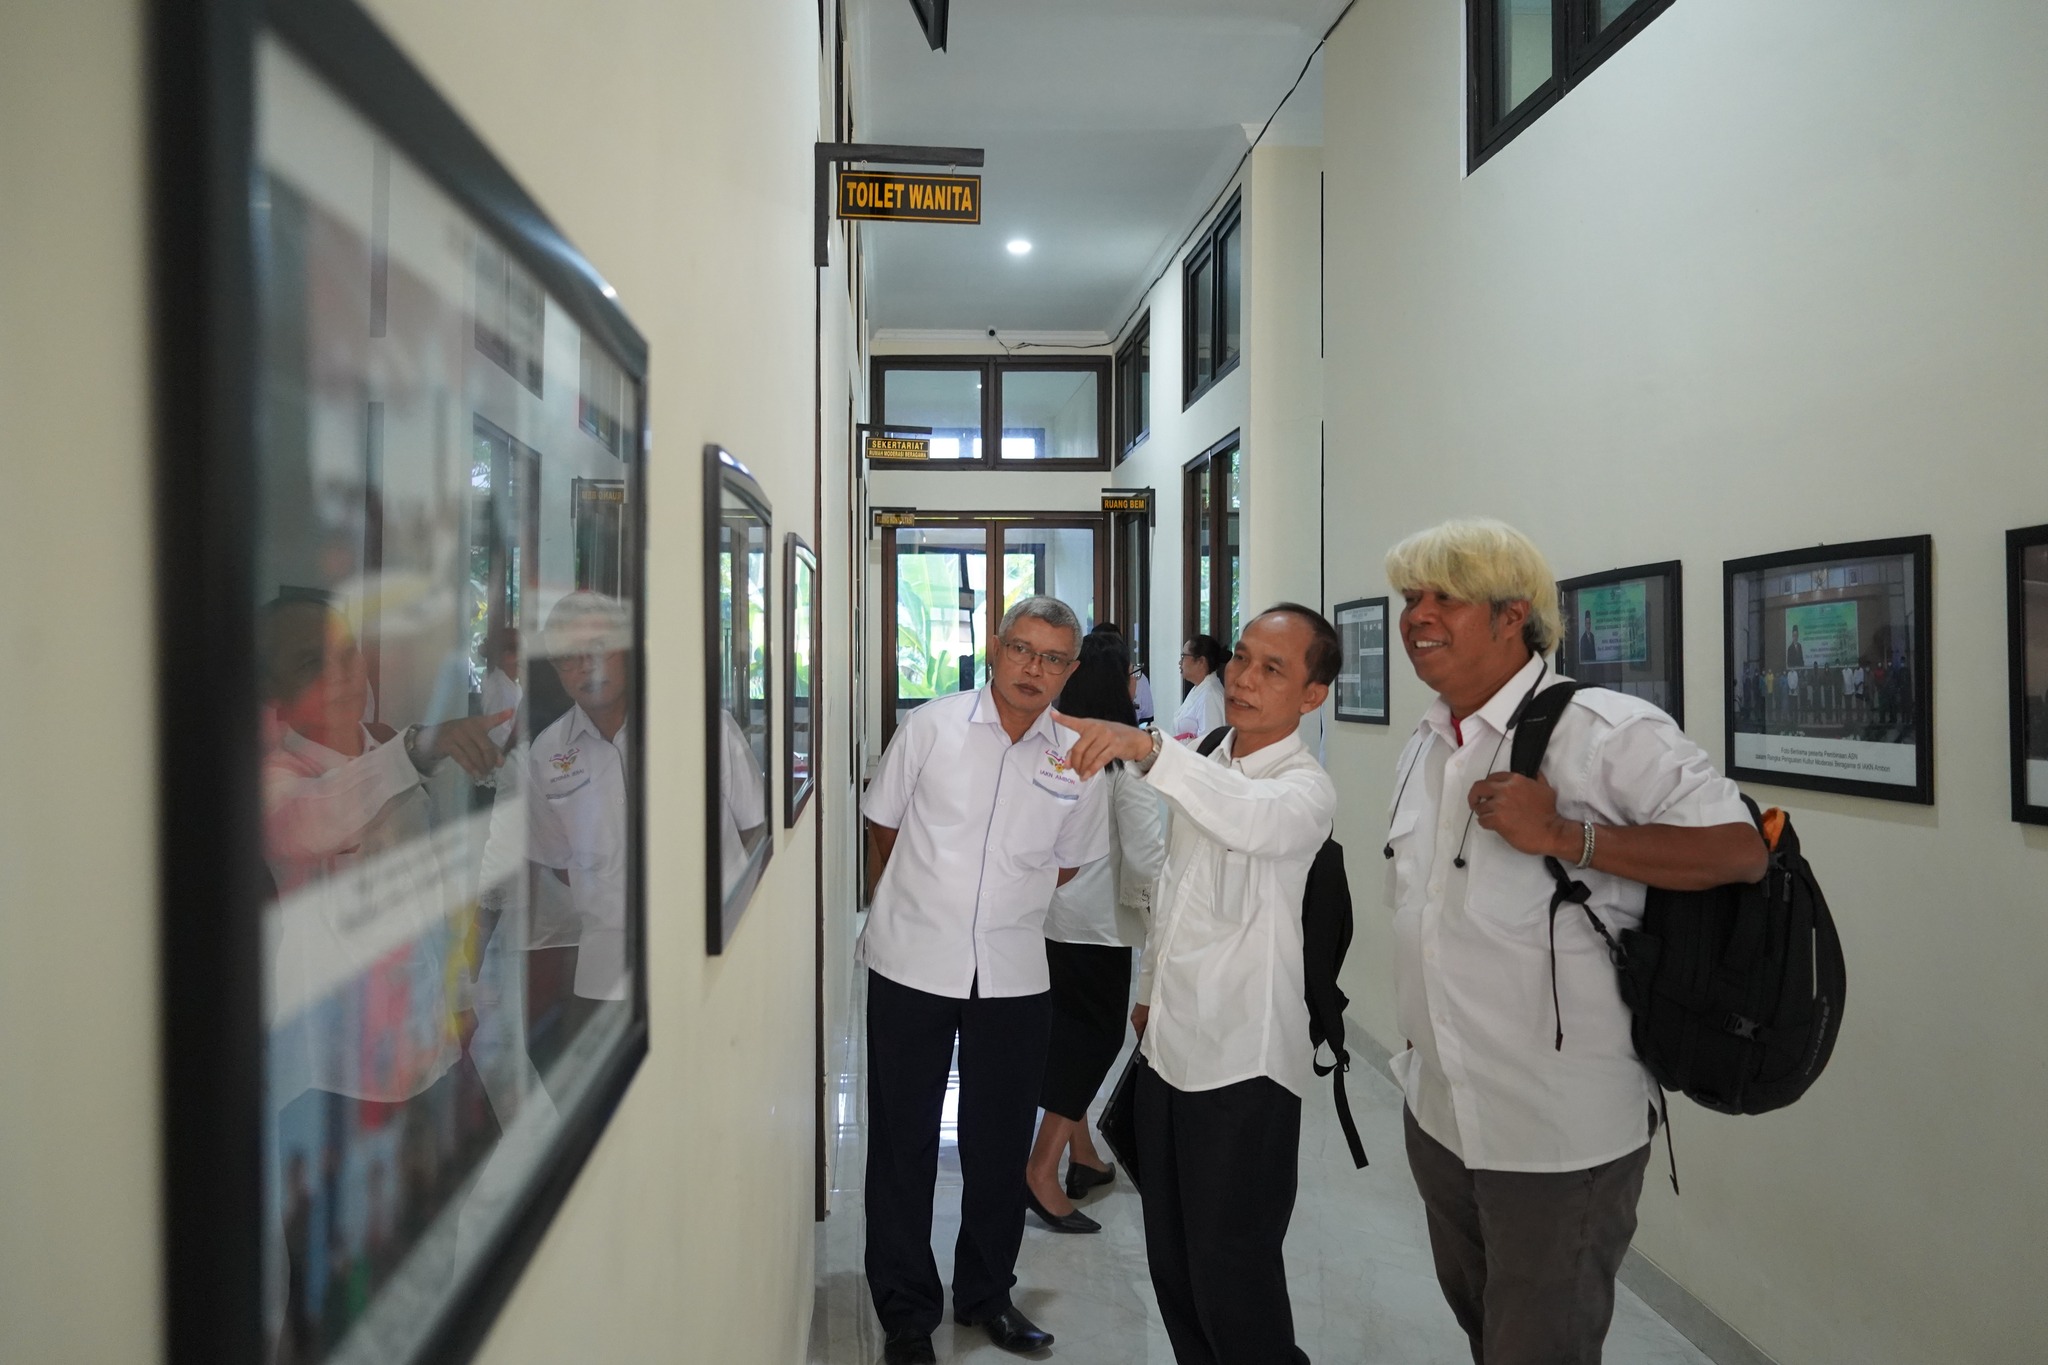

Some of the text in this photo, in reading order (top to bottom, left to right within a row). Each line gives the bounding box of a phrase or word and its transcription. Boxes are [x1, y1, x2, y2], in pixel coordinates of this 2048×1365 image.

[846, 181, 973, 212] TOILET WANITA
[872, 440, 924, 450] SEKERTARIAT
[1104, 499, 1145, 509] RUANG BEM
[1848, 752, 1858, 760] ASN
[1040, 769, 1076, 785] IAKN AMBON
